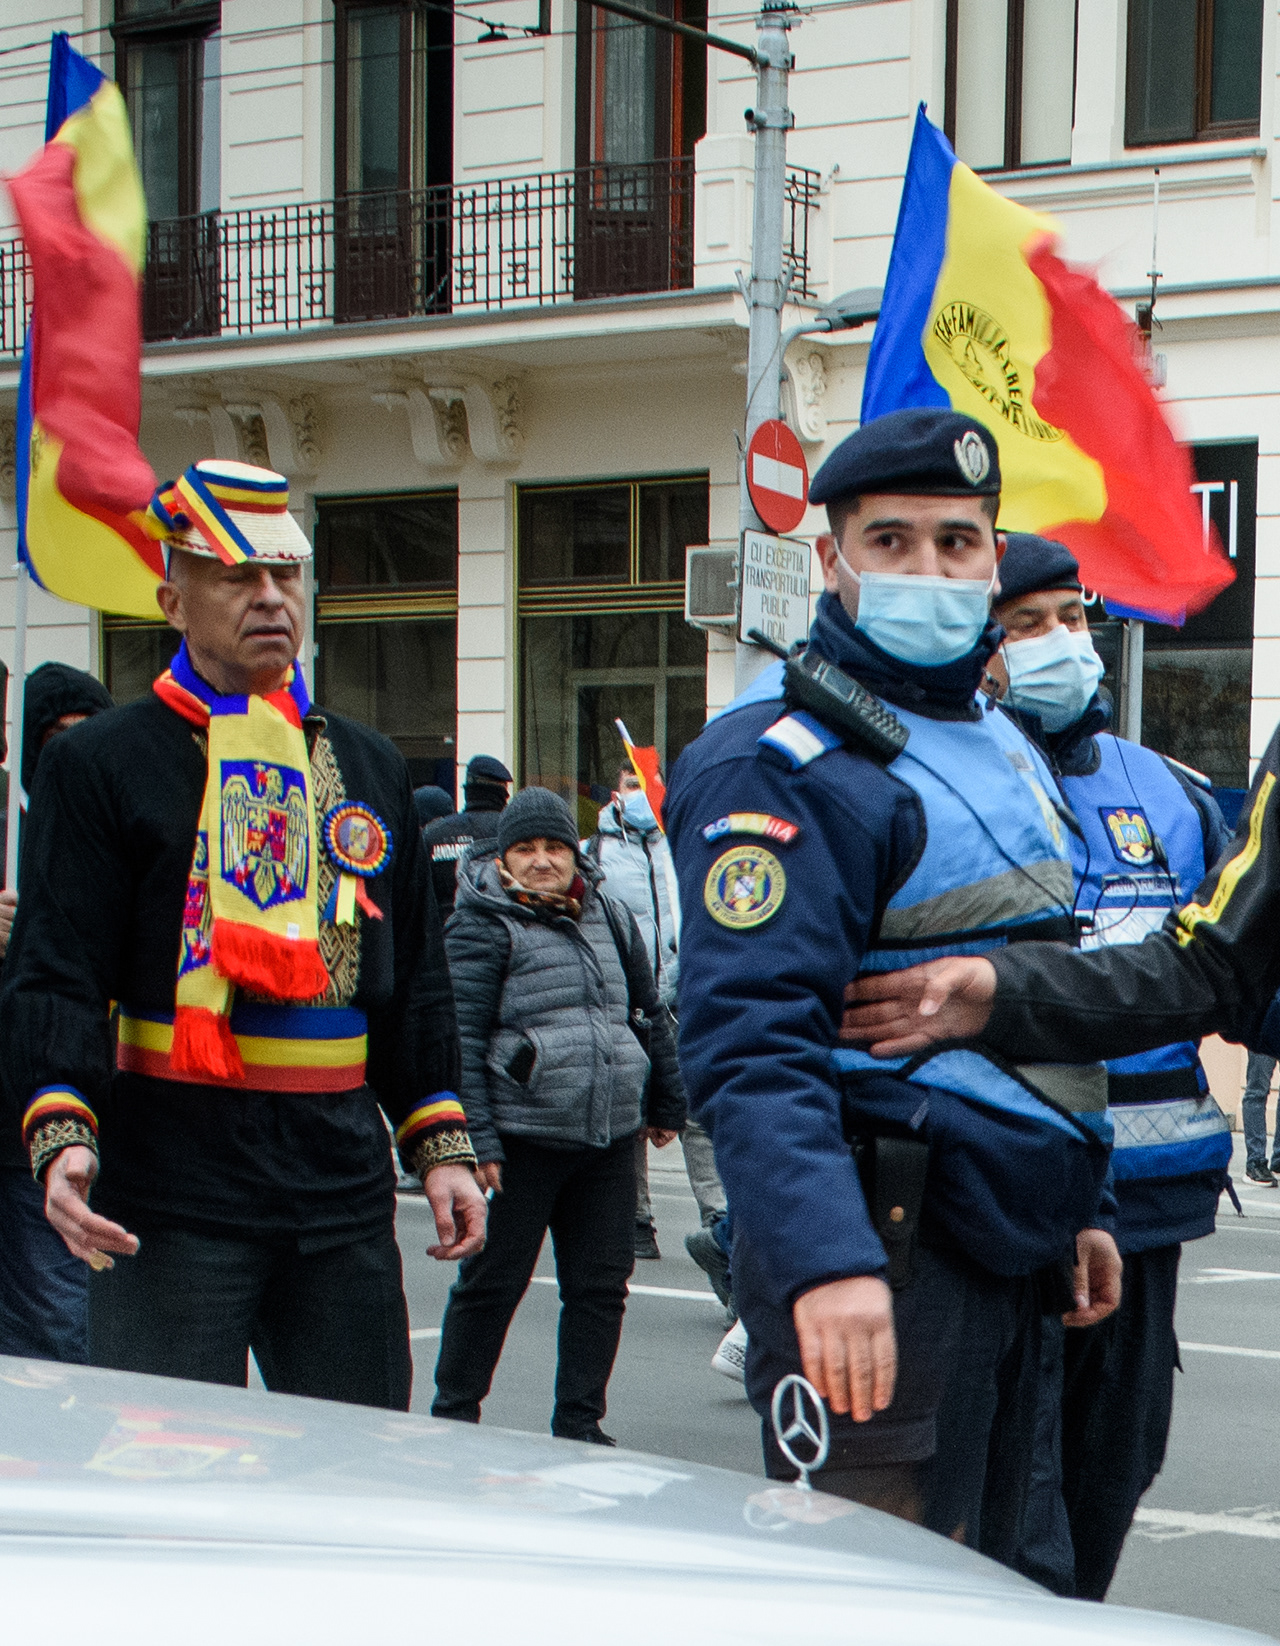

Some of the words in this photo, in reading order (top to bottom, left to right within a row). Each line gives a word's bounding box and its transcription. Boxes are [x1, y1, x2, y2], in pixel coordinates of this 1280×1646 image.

[750, 541, 762, 563] CU
[745, 564, 808, 598] TRANSPORTULUI
[761, 593, 790, 618] PUBLIC
[761, 618, 787, 642] LOCAL
